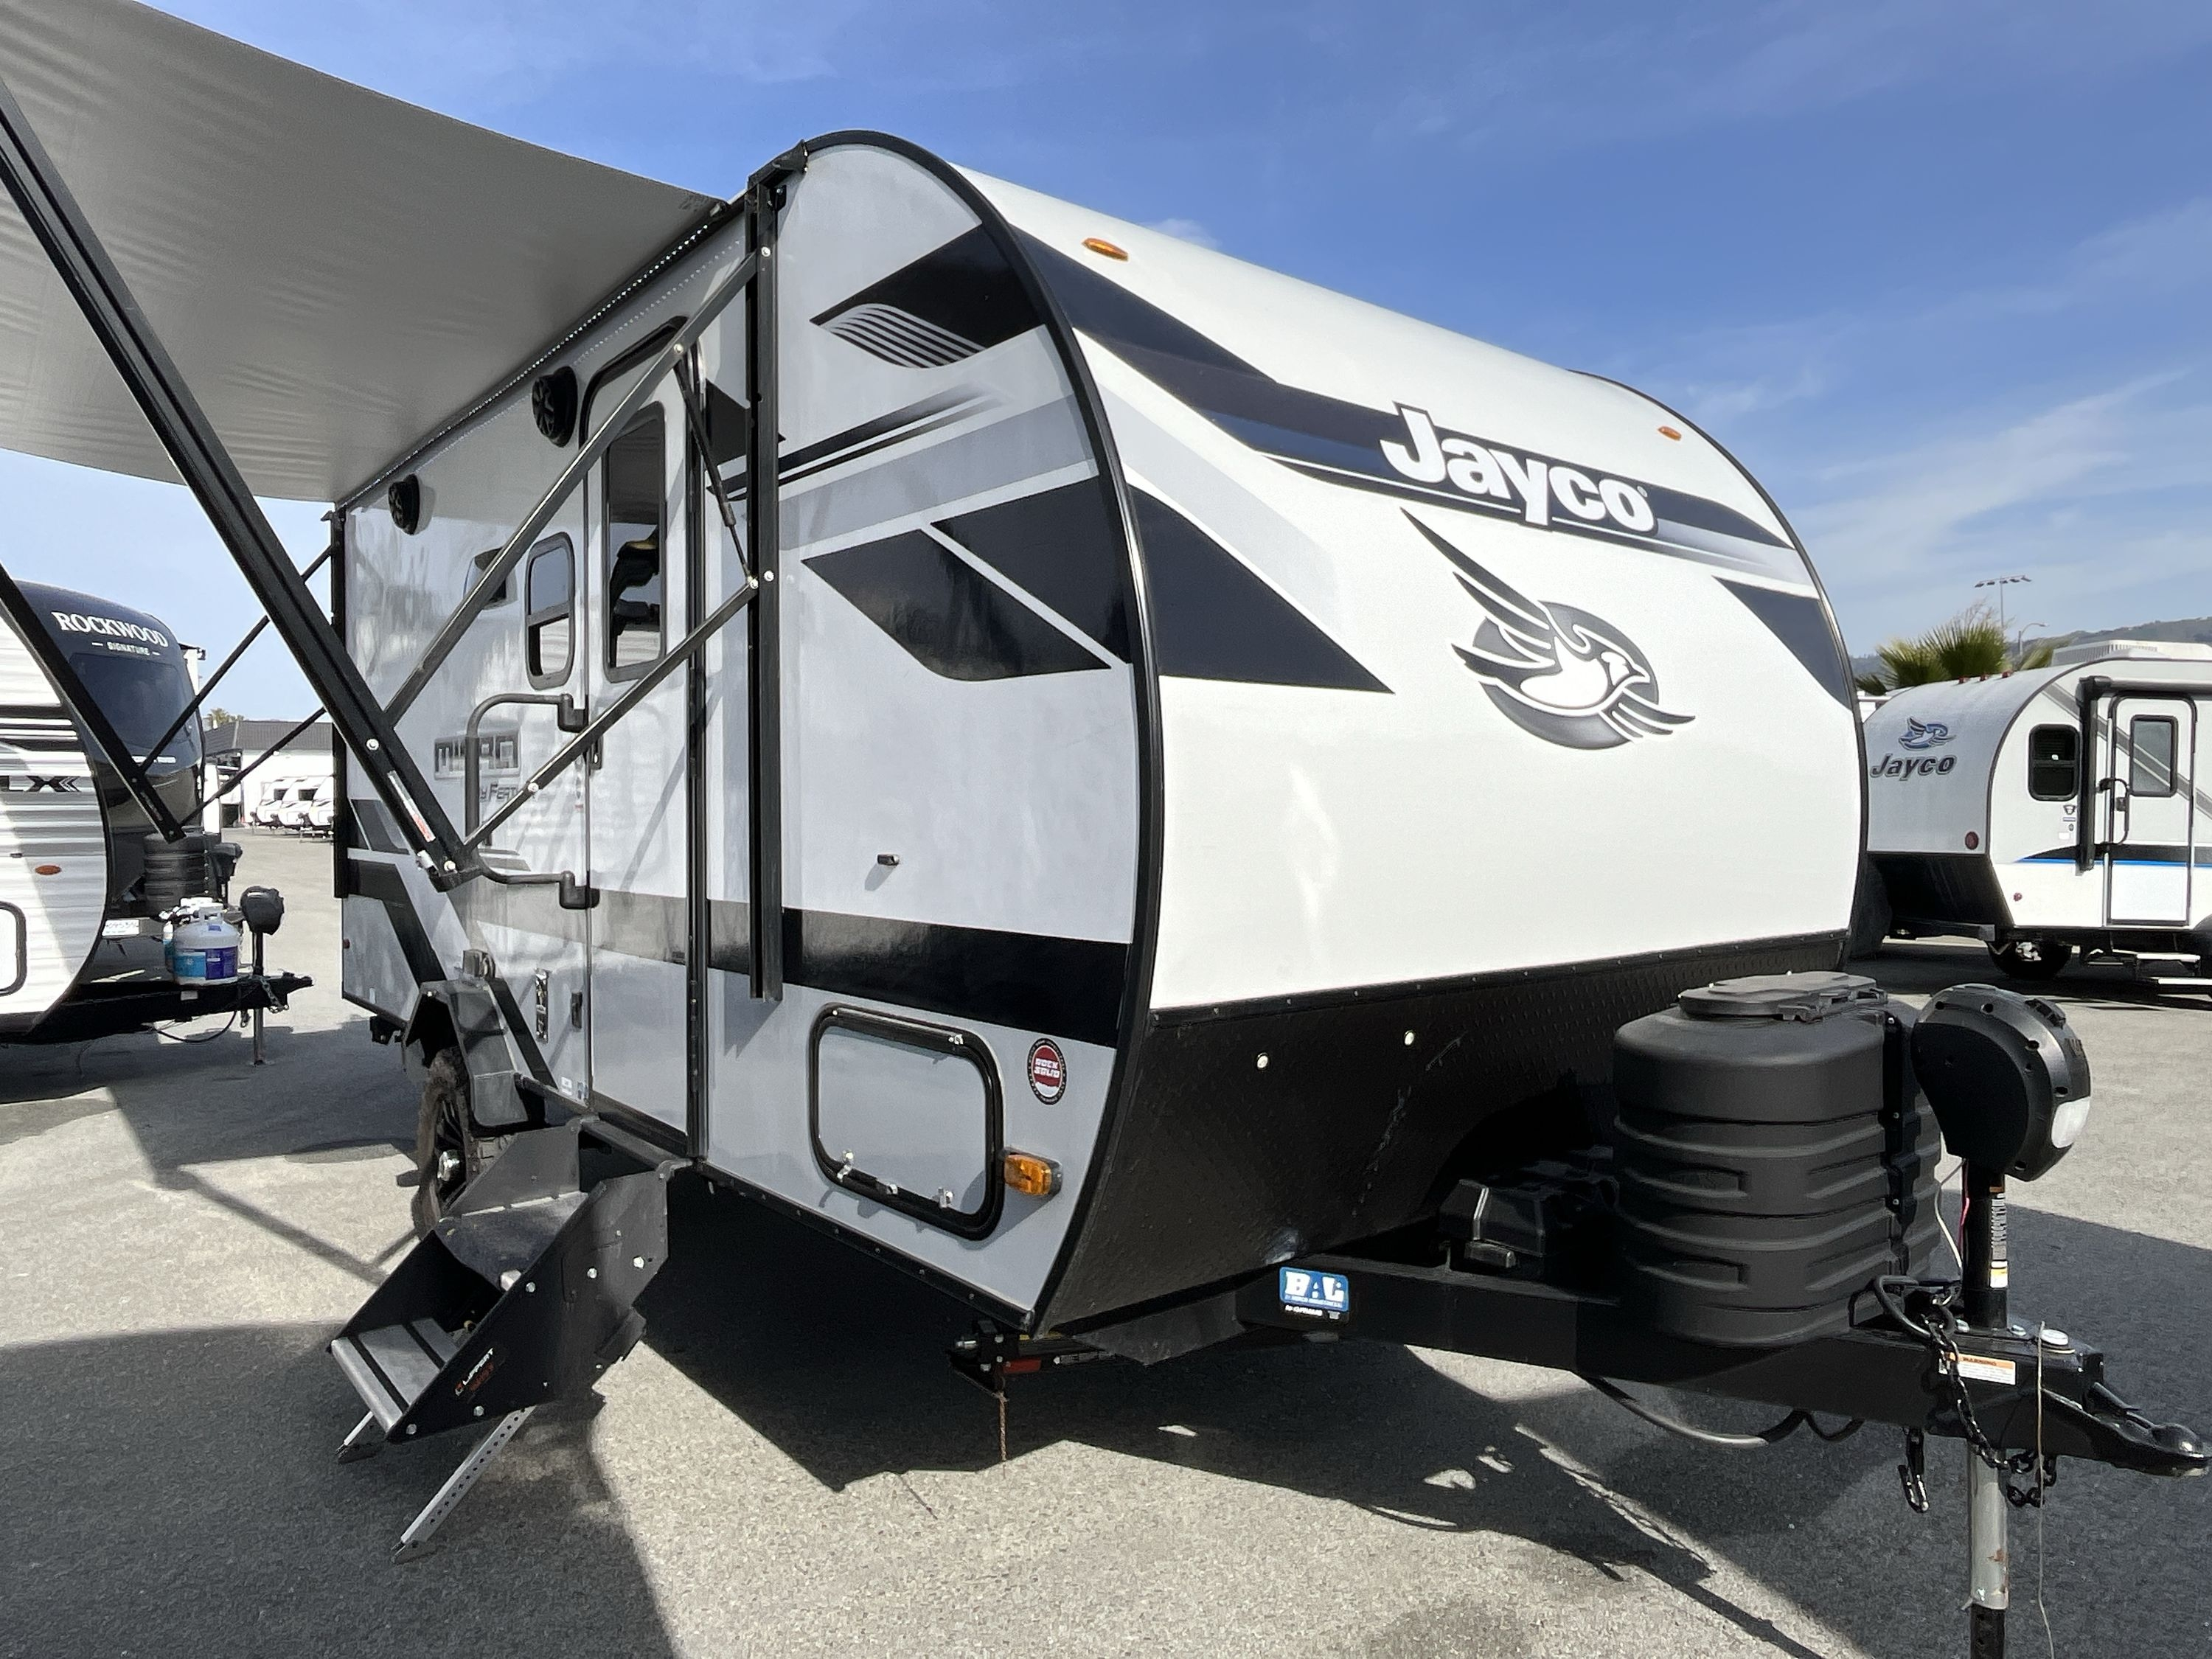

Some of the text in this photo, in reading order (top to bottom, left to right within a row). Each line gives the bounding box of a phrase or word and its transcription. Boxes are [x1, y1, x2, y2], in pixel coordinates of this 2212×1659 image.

[1379, 403, 1656, 532] Jayco
[51, 611, 169, 648] ROCKWOOD
[107, 641, 150, 656] SIGNATURE
[1869, 753, 1958, 782] Jayco
